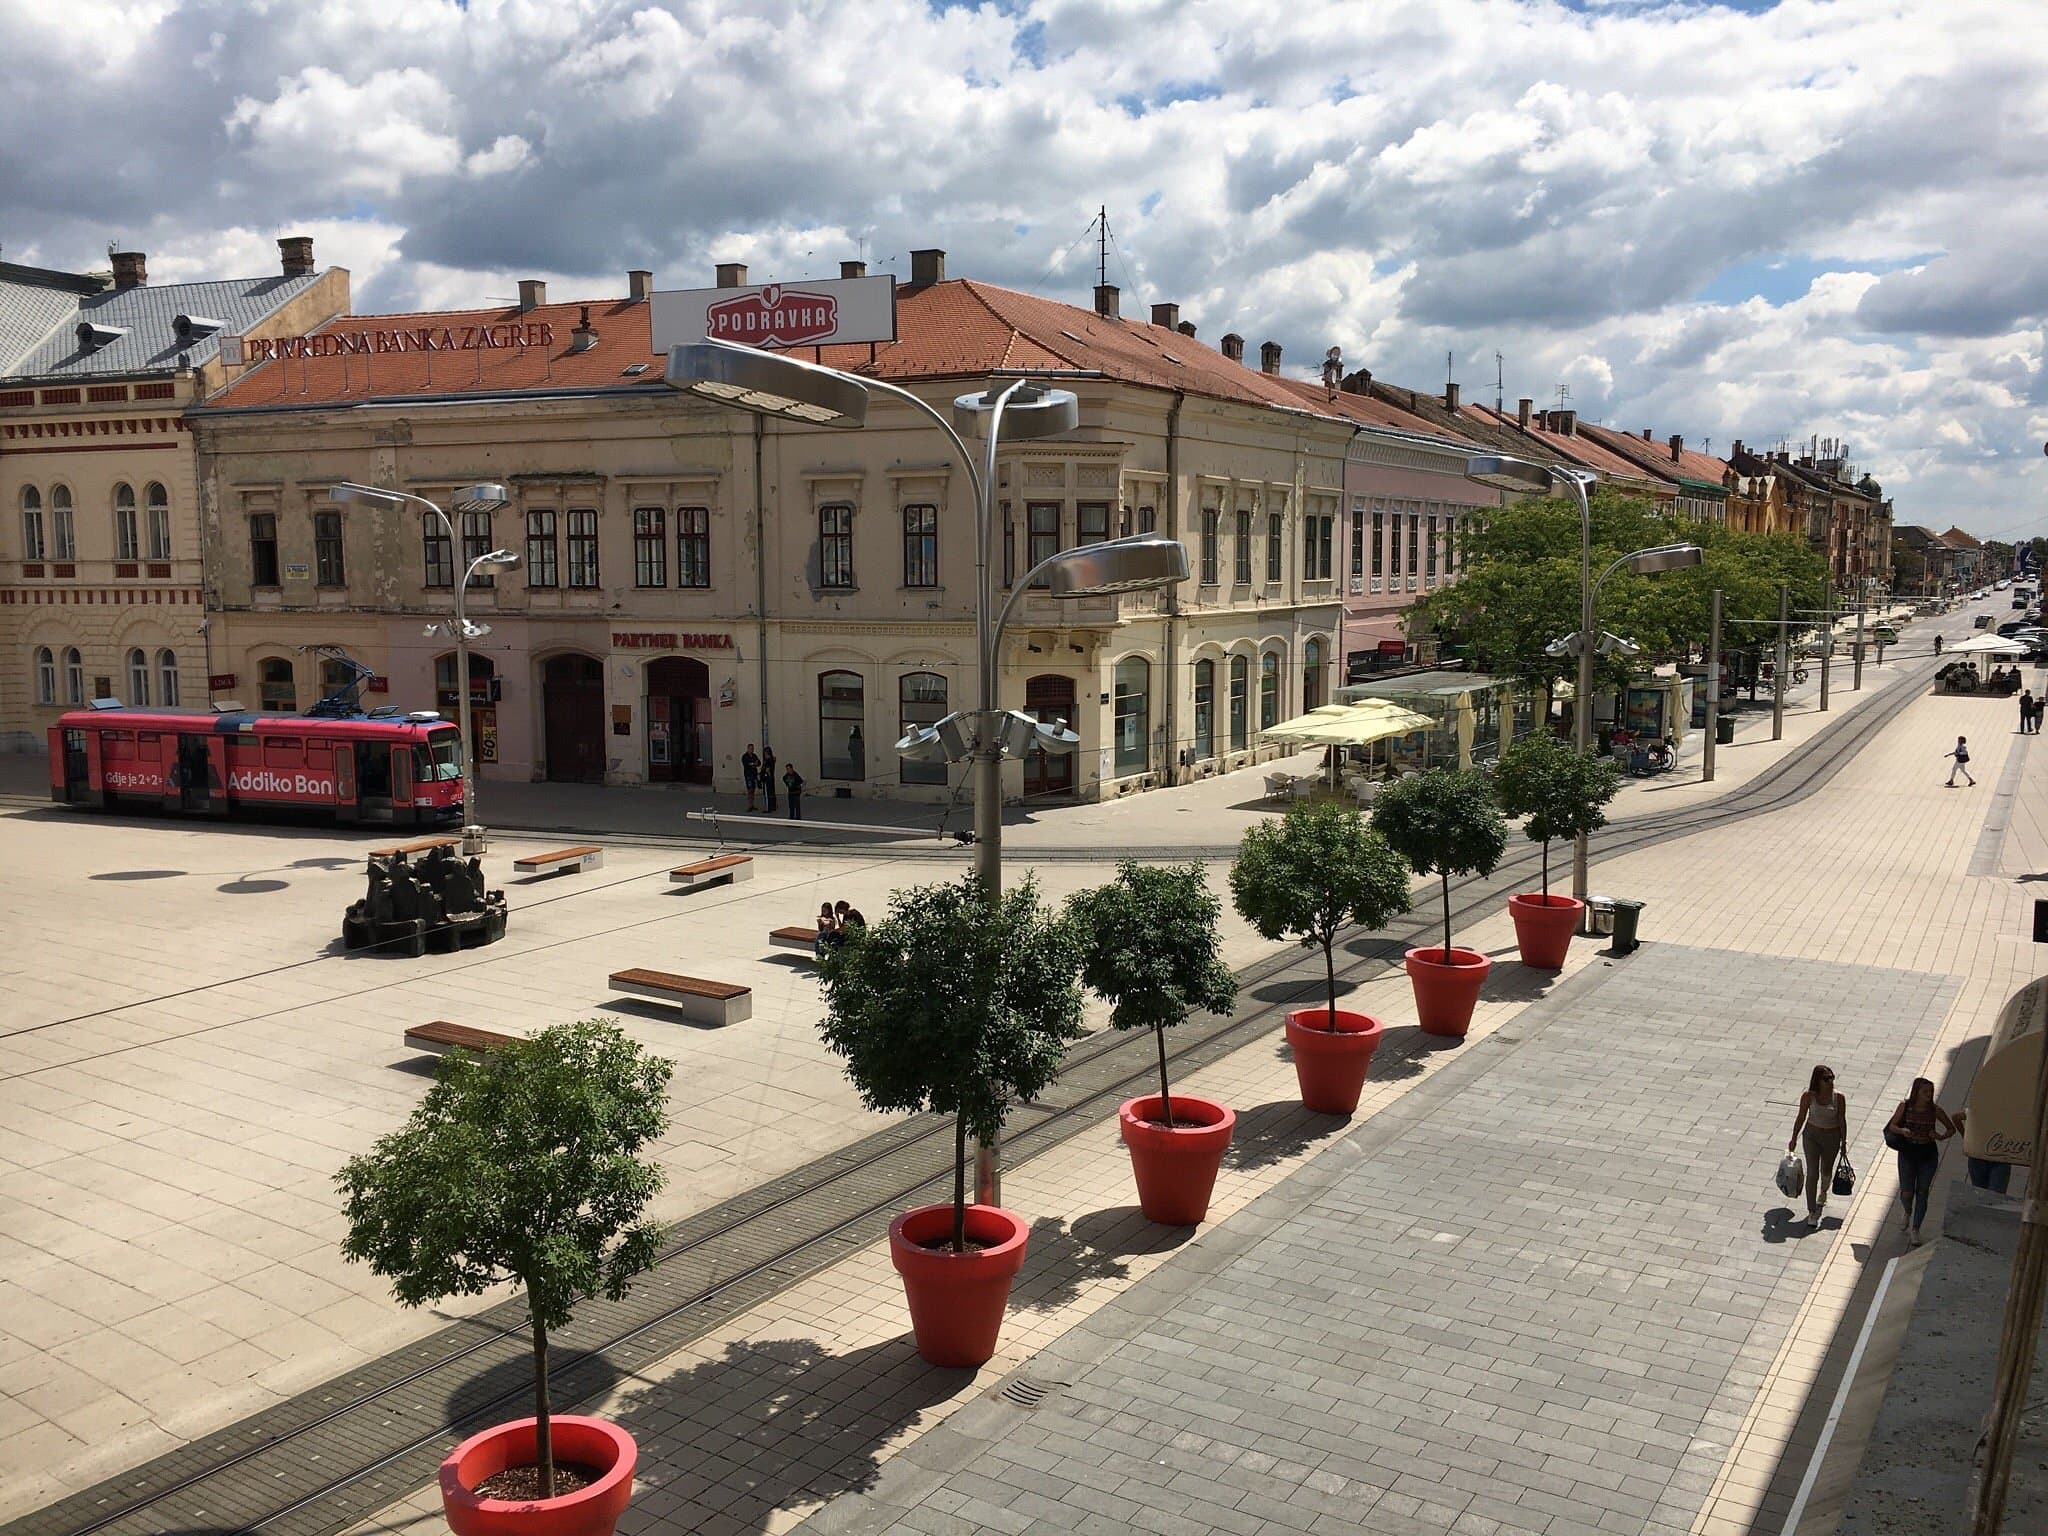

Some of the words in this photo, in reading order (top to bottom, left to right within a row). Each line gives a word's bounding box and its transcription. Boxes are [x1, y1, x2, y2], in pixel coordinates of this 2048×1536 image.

[718, 307, 826, 332] PODRAVKA
[250, 331, 373, 361] PRIVREDNA
[375, 328, 457, 353] BANKA
[461, 323, 554, 350] ZAGREB
[612, 633, 679, 649] PARTNER
[682, 633, 735, 649] BANKA
[105, 771, 127, 787] Gdje
[127, 773, 137, 787] je
[228, 771, 292, 793] Addiko
[295, 774, 344, 796] Ban
